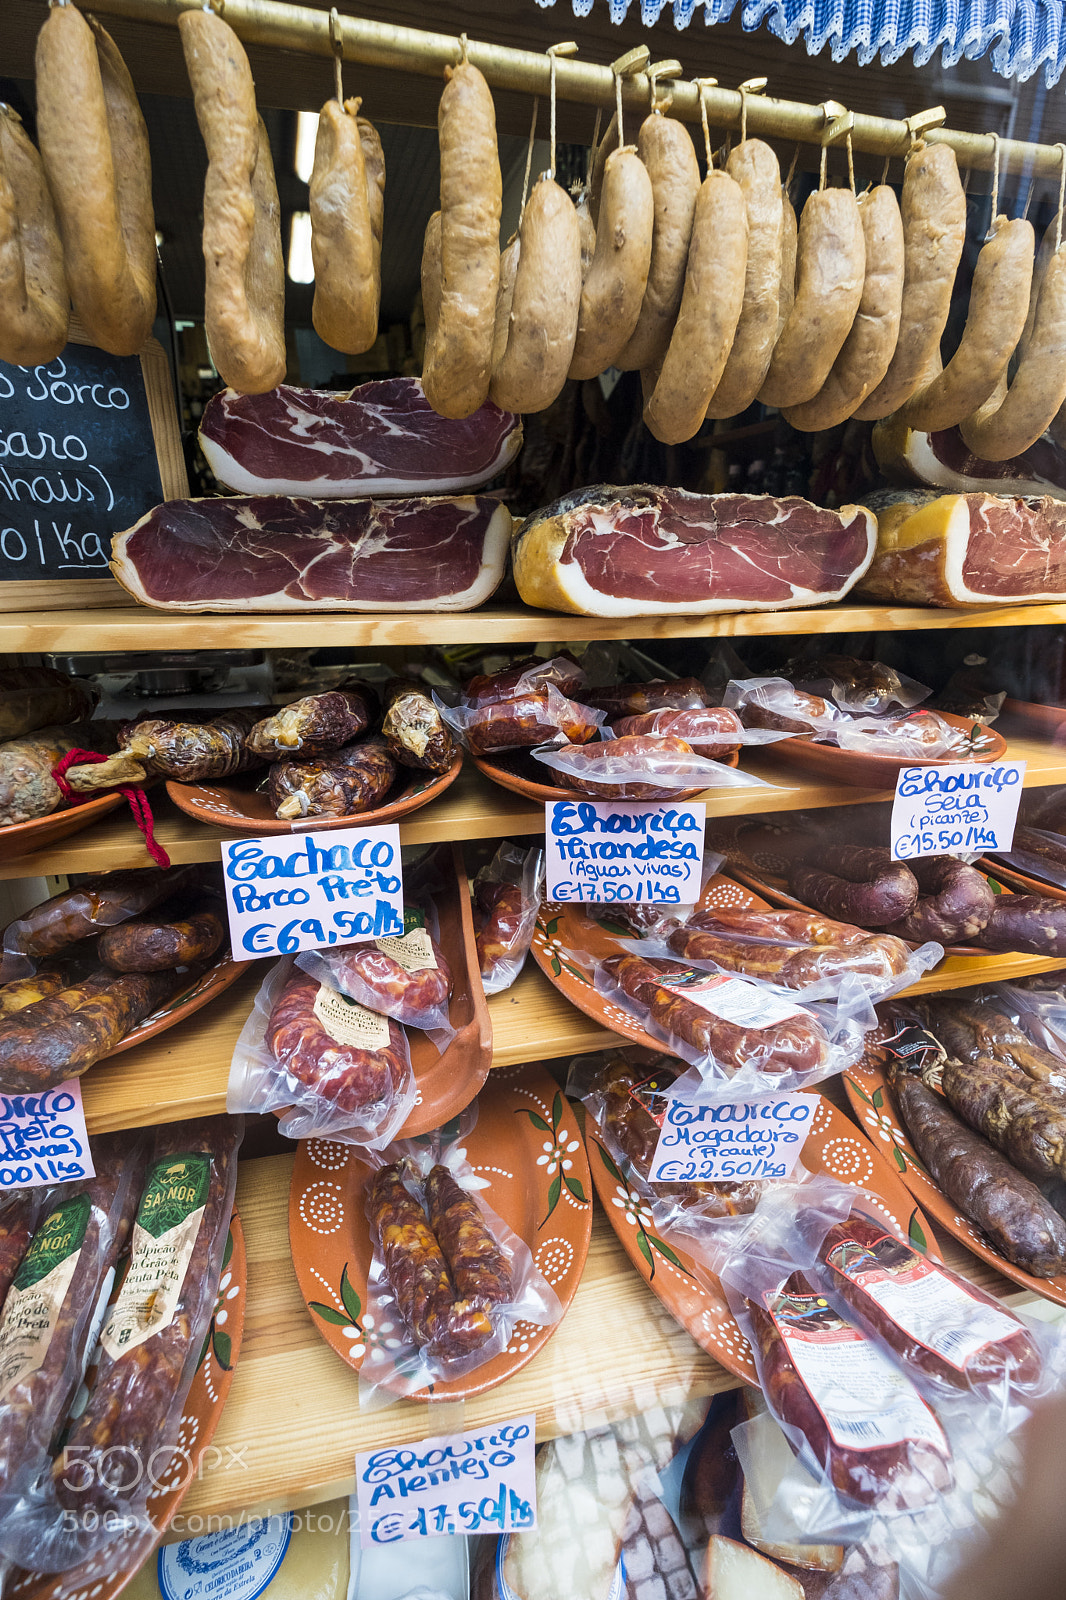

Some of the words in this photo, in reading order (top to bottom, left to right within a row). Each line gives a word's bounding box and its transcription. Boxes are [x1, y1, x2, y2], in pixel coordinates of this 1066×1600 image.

[925, 793, 986, 813] Seia
[232, 883, 310, 914] Porco
[317, 871, 402, 902] Preto
[34, 1302, 49, 1315] de
[17, 1318, 50, 1329] Preta
